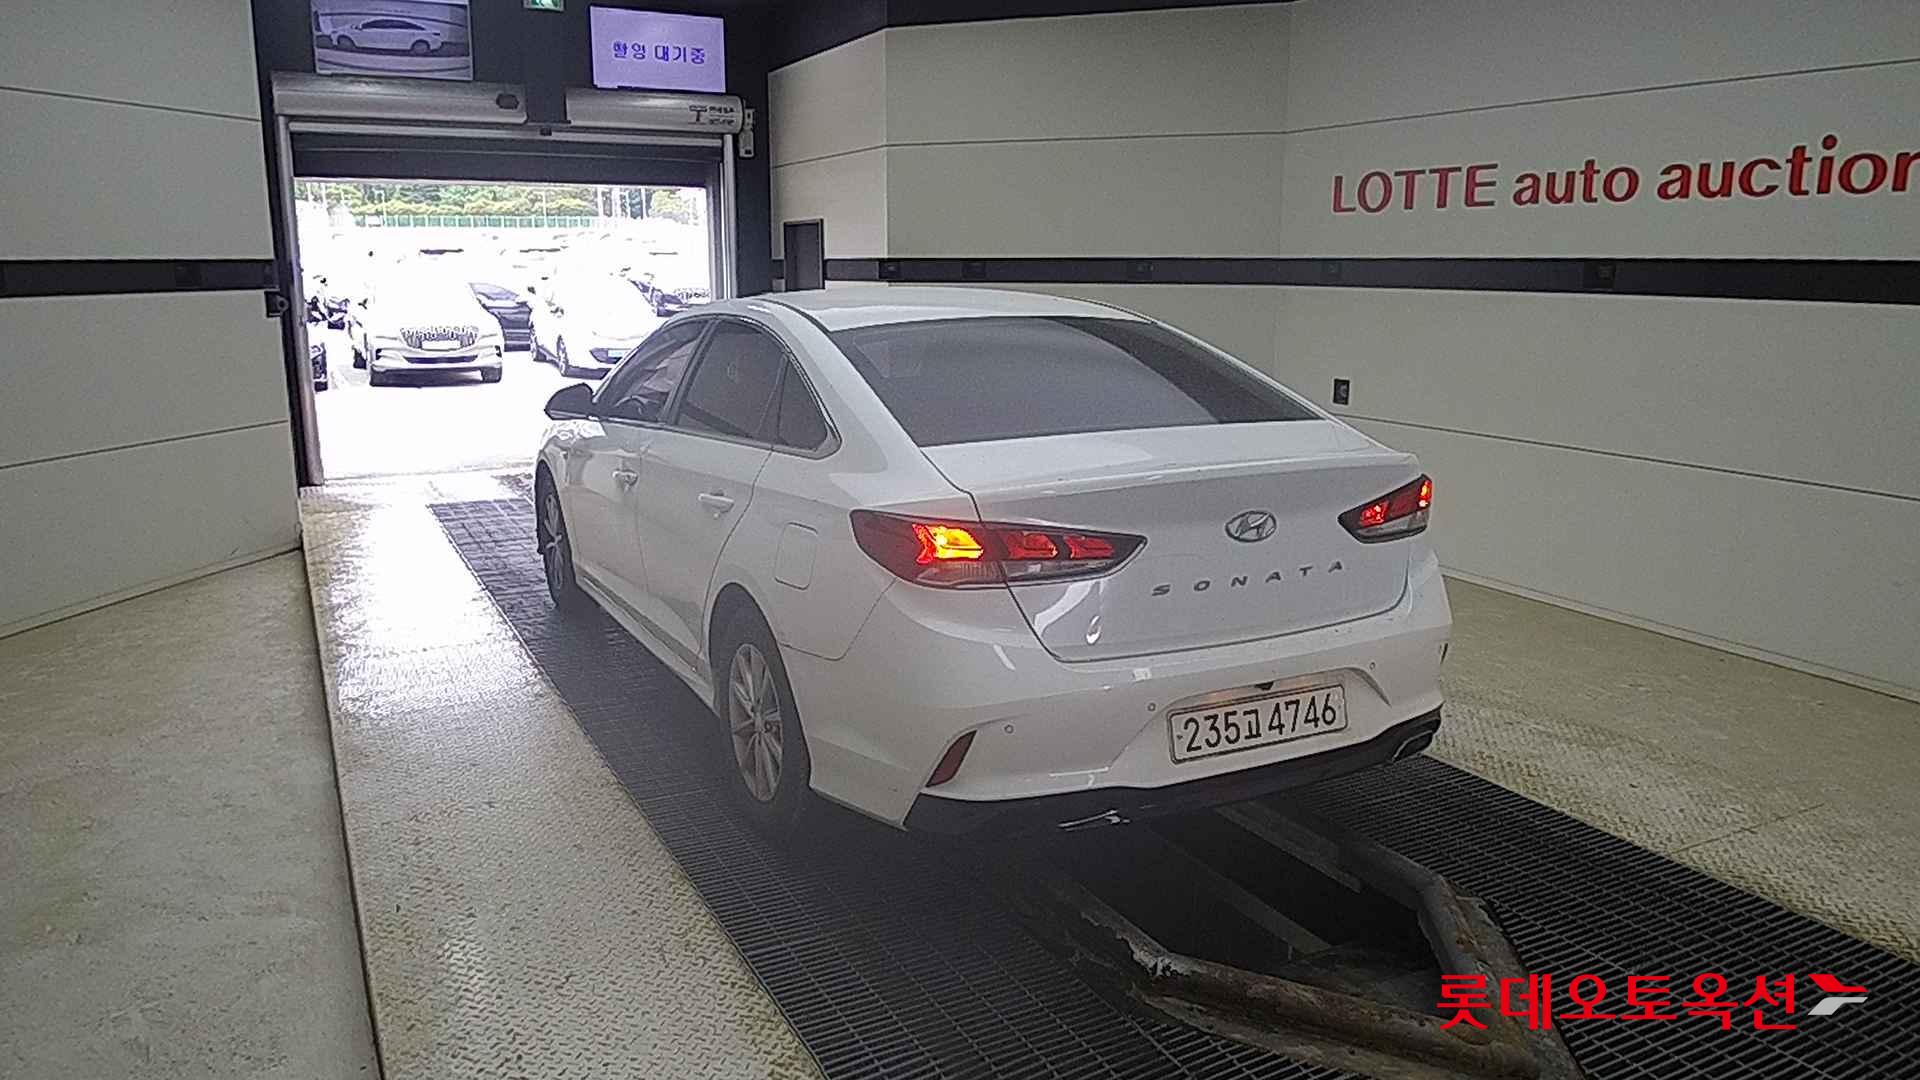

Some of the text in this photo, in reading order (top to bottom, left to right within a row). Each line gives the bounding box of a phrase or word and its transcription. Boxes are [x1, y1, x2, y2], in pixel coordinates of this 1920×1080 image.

[654, 44, 706, 65] 대기중
[1332, 163, 1499, 213] LOTTE
[1513, 158, 1639, 206] auto
[1152, 560, 1344, 597] SONATA
[1268, 693, 1337, 736] 4746
